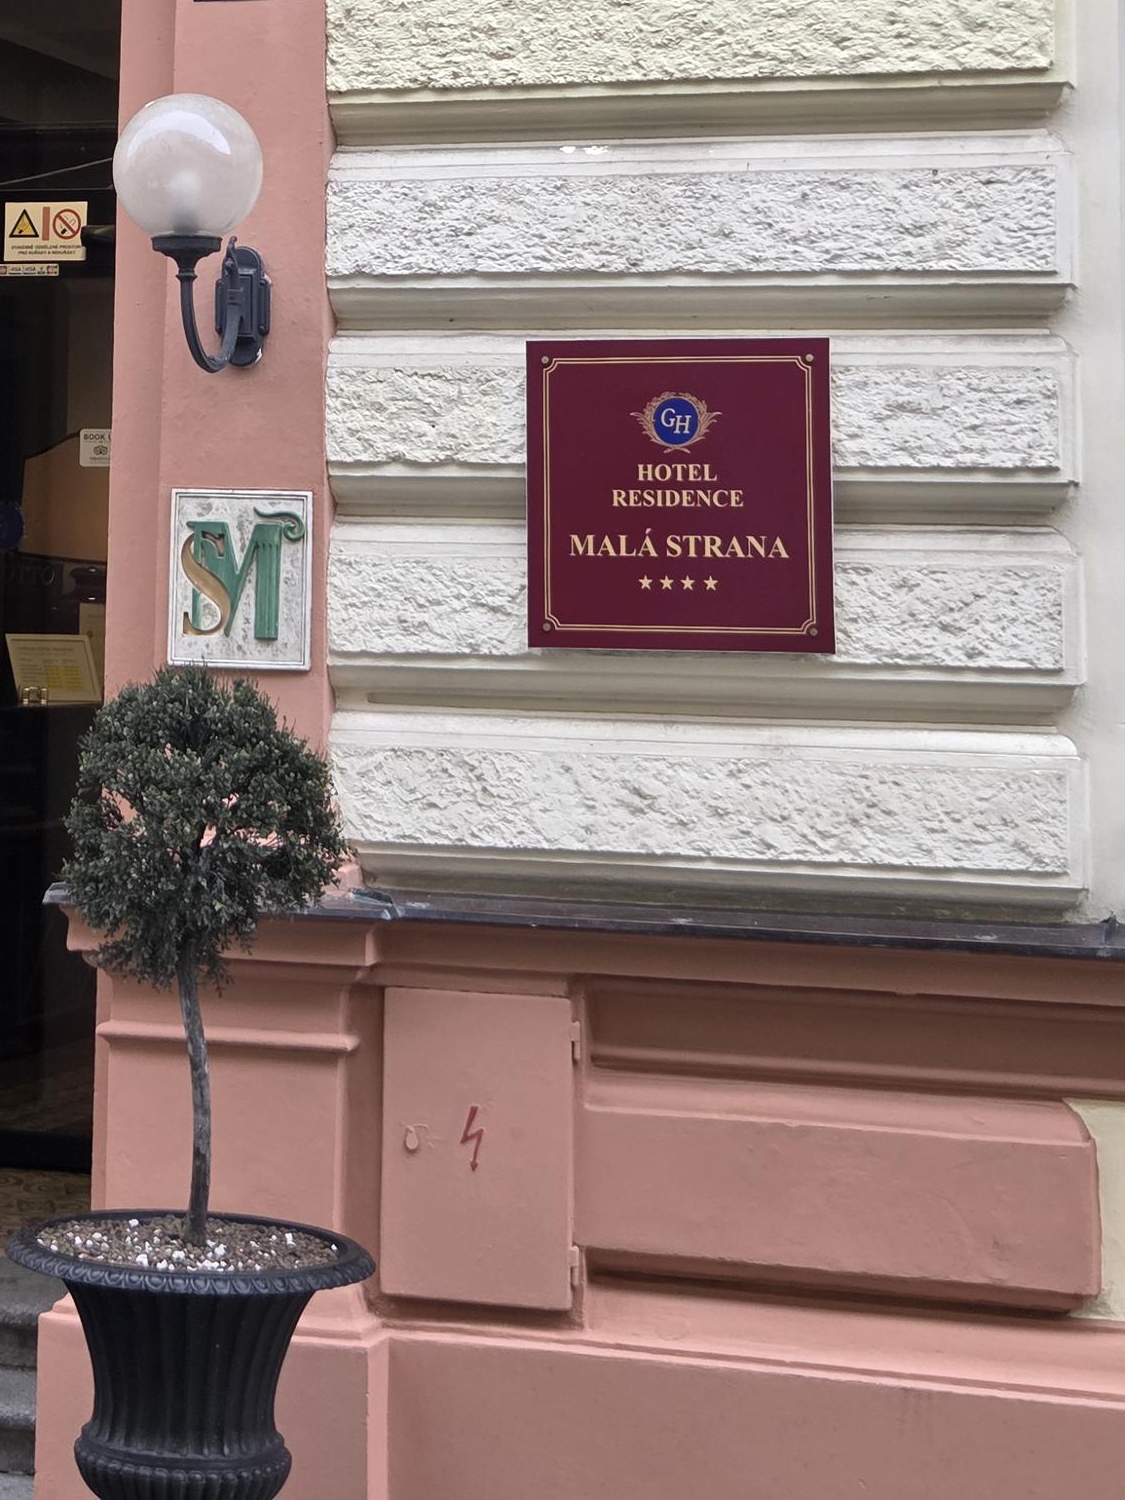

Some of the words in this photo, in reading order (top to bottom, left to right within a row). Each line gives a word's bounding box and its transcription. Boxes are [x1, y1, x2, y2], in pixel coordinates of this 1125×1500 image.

[660, 408, 692, 434] GH
[637, 463, 718, 482] HOTEL
[612, 489, 744, 508] RESIDENCE
[570, 527, 659, 557] MALÁ
[666, 534, 790, 559] STRANA
